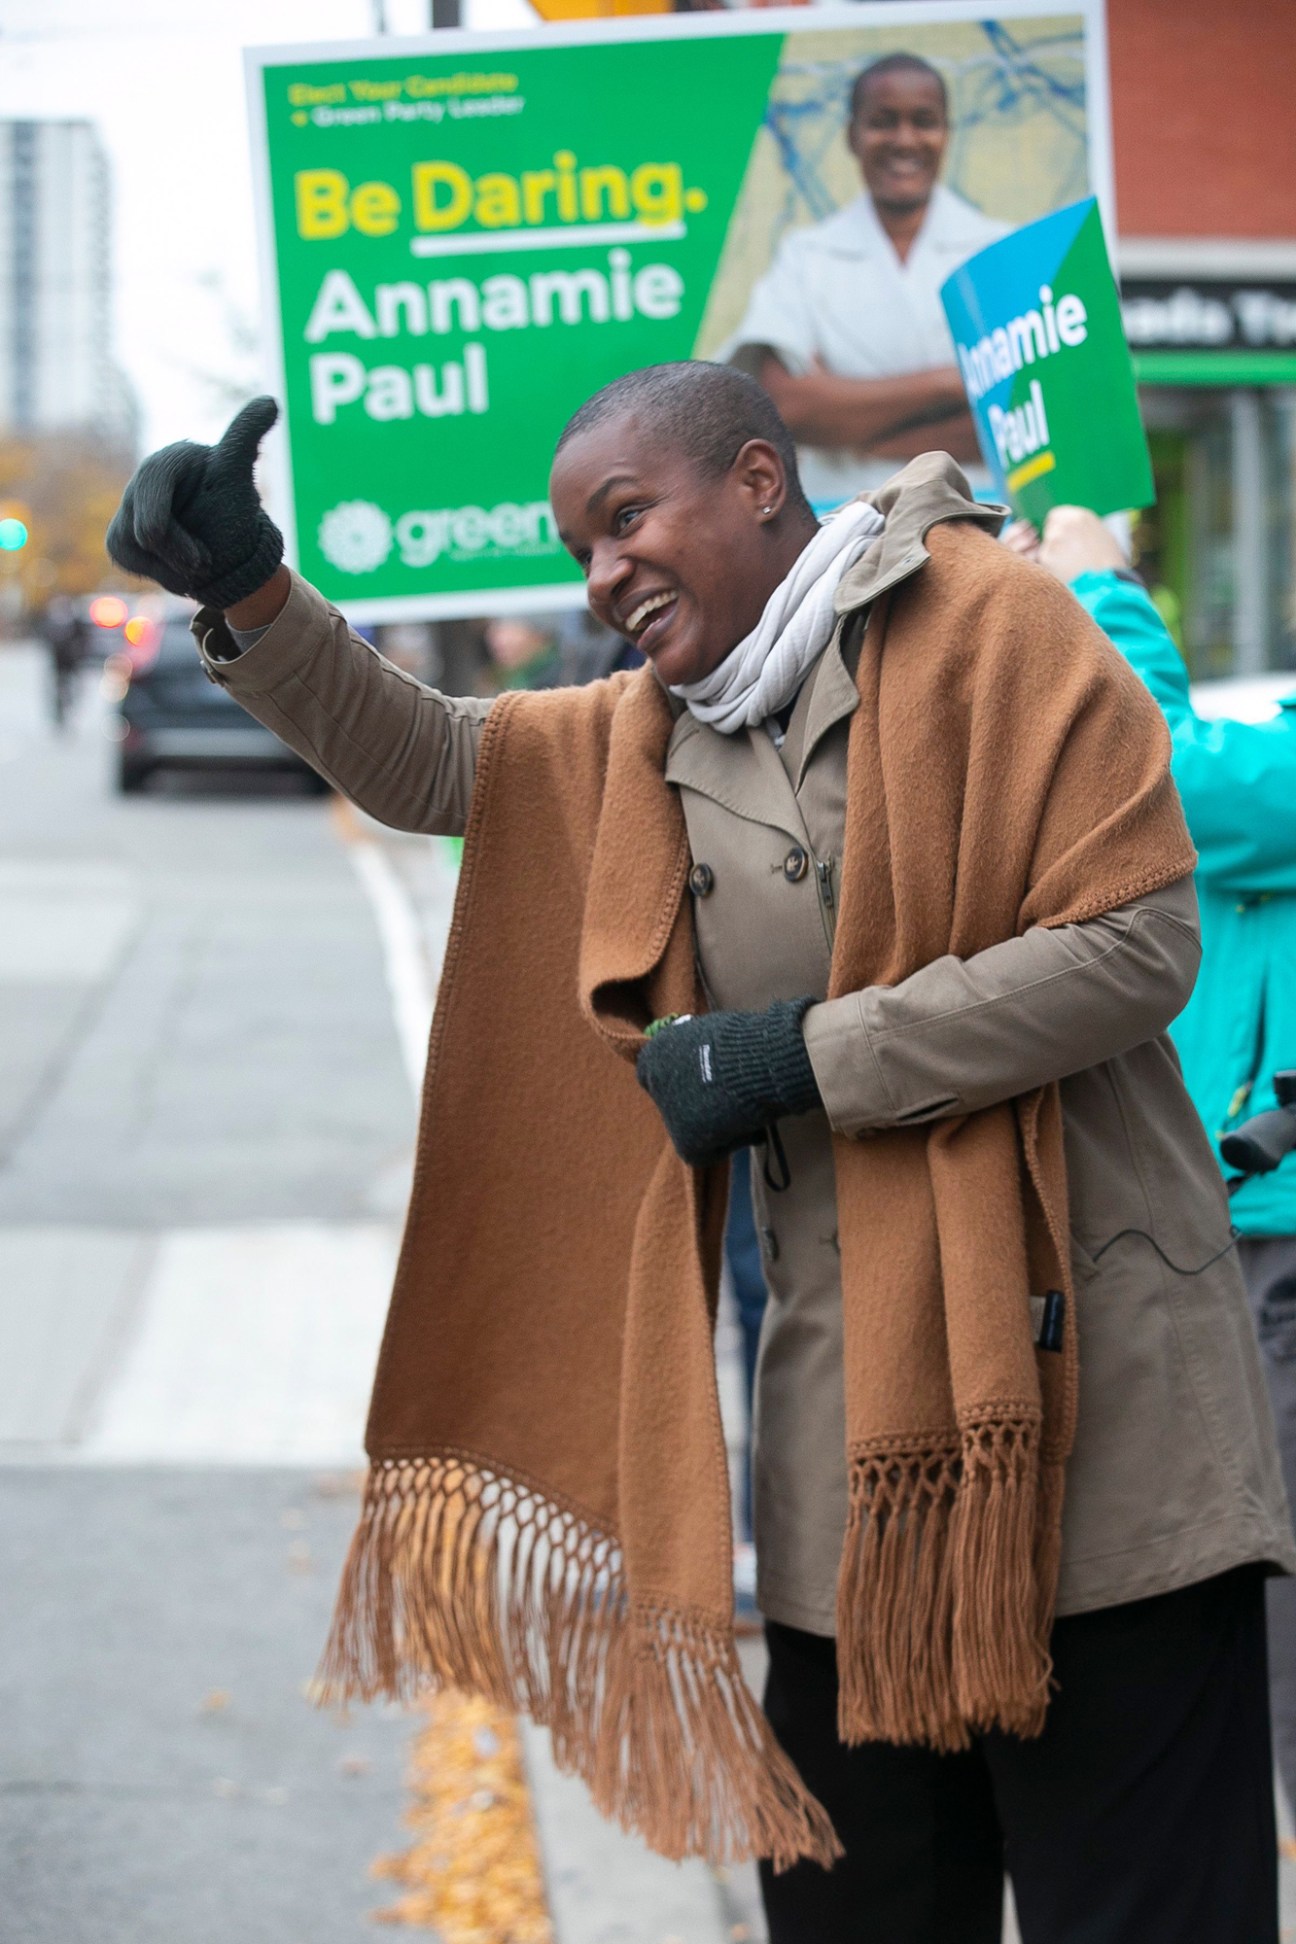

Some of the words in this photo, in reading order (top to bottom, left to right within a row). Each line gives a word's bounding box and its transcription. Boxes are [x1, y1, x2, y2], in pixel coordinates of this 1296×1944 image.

[311, 105, 382, 127] Green
[295, 168, 400, 240] Be
[412, 150, 707, 230] Daring.
[304, 248, 684, 343] Annamie
[310, 342, 488, 424] Paul
[987, 379, 1050, 470] Paul
[396, 501, 559, 568] green
